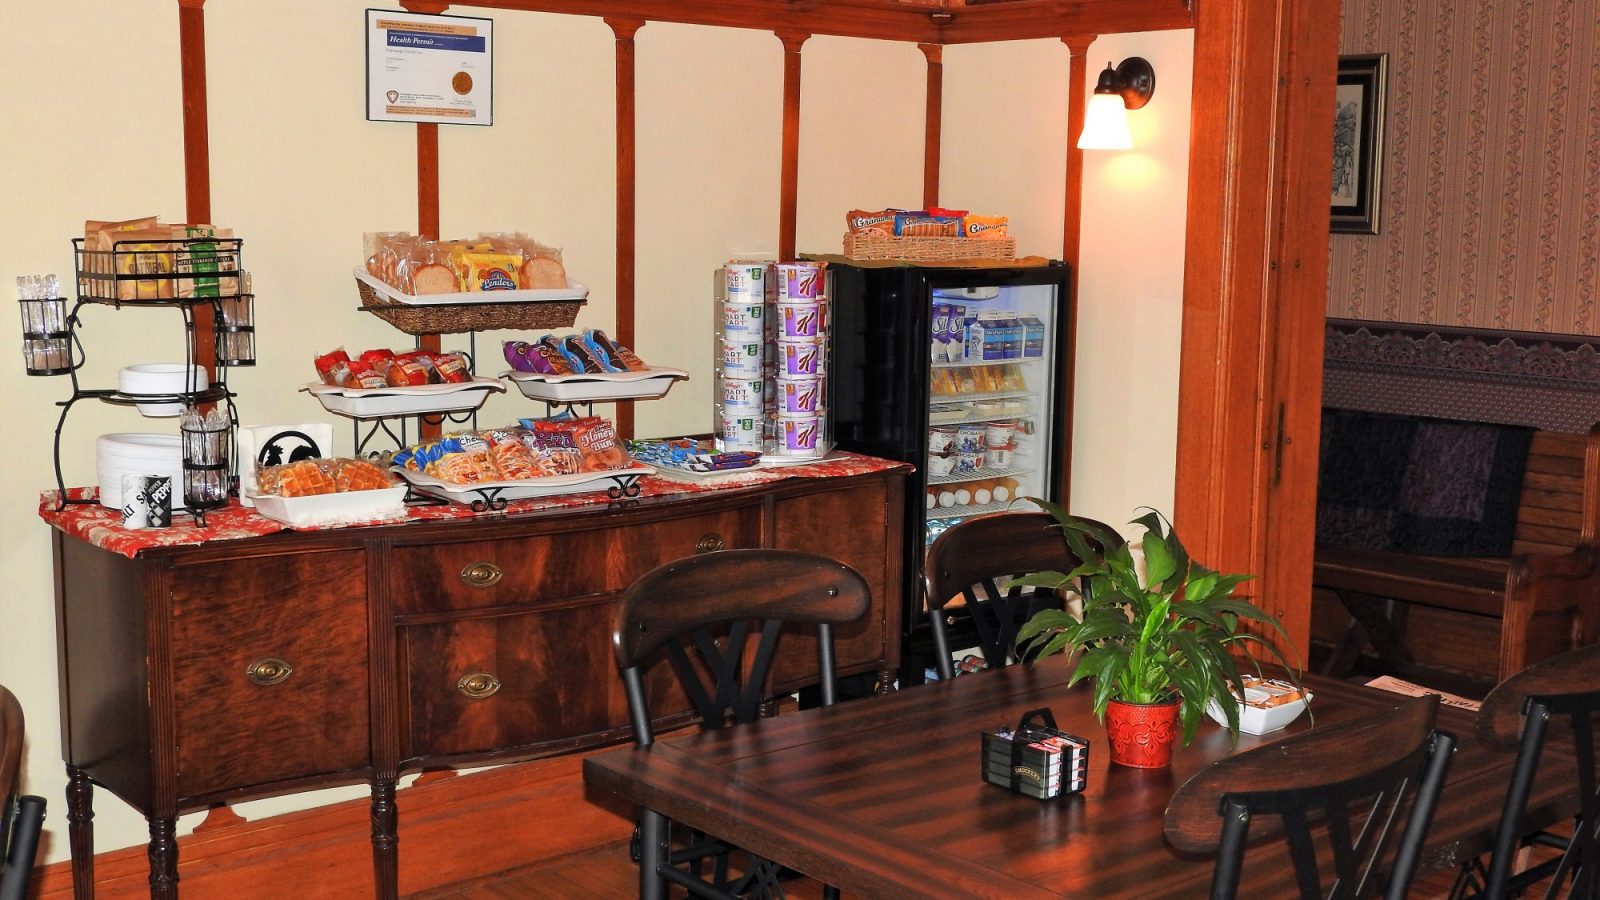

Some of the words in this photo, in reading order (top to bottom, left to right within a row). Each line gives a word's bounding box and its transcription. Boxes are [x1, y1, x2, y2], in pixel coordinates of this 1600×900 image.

[389, 35, 412, 44] Health
[412, 37, 434, 46] Permit
[932, 316, 949, 333] Sil
[580, 427, 616, 447] Honey
[590, 439, 616, 453] Bun
[151, 478, 172, 504] PEPPE
